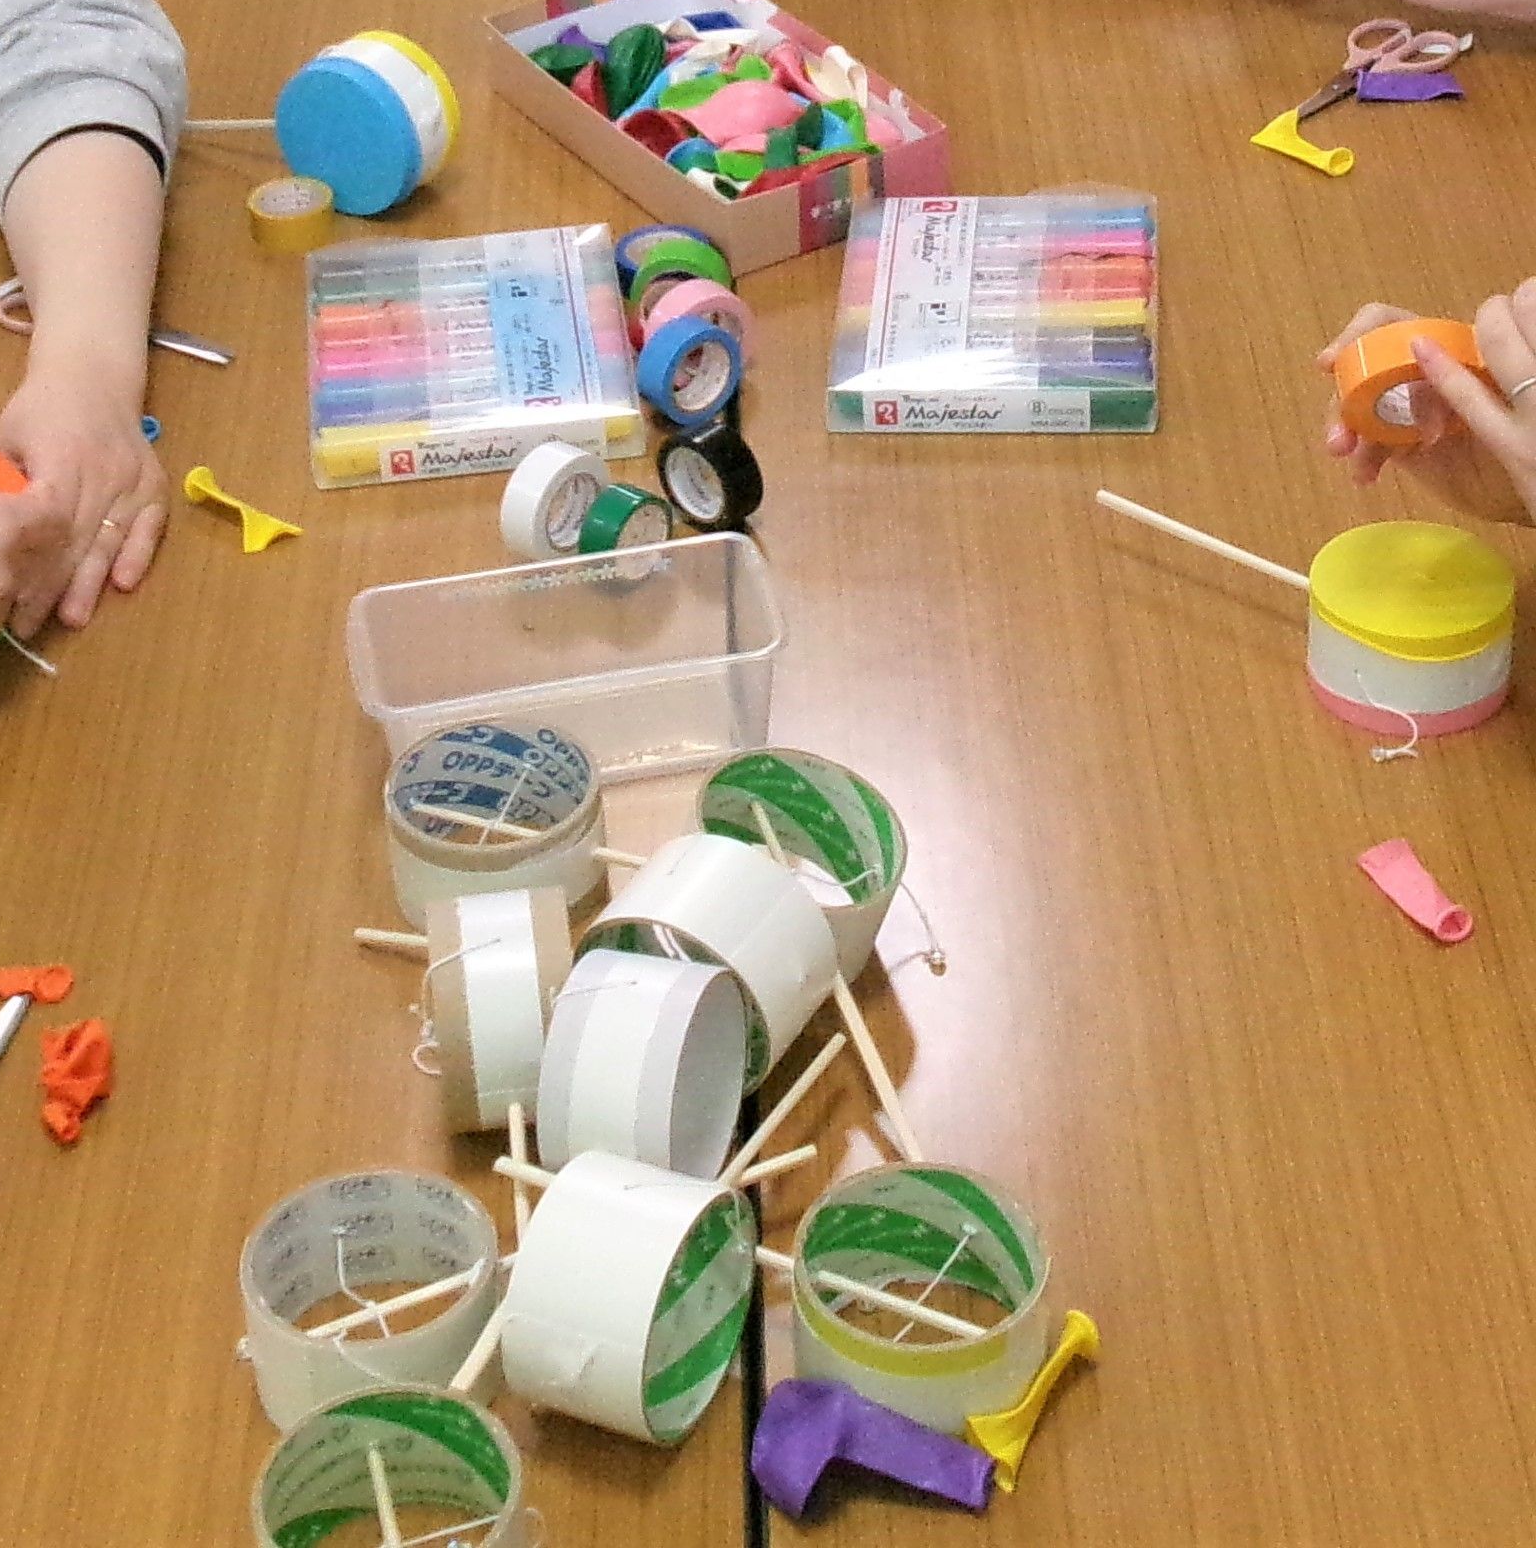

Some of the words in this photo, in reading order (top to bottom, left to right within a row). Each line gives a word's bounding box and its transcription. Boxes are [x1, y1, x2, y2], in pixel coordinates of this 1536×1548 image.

[534, 337, 557, 393] Majestar
[905, 403, 1002, 423] Majestar
[422, 443, 517, 466] Majestar
